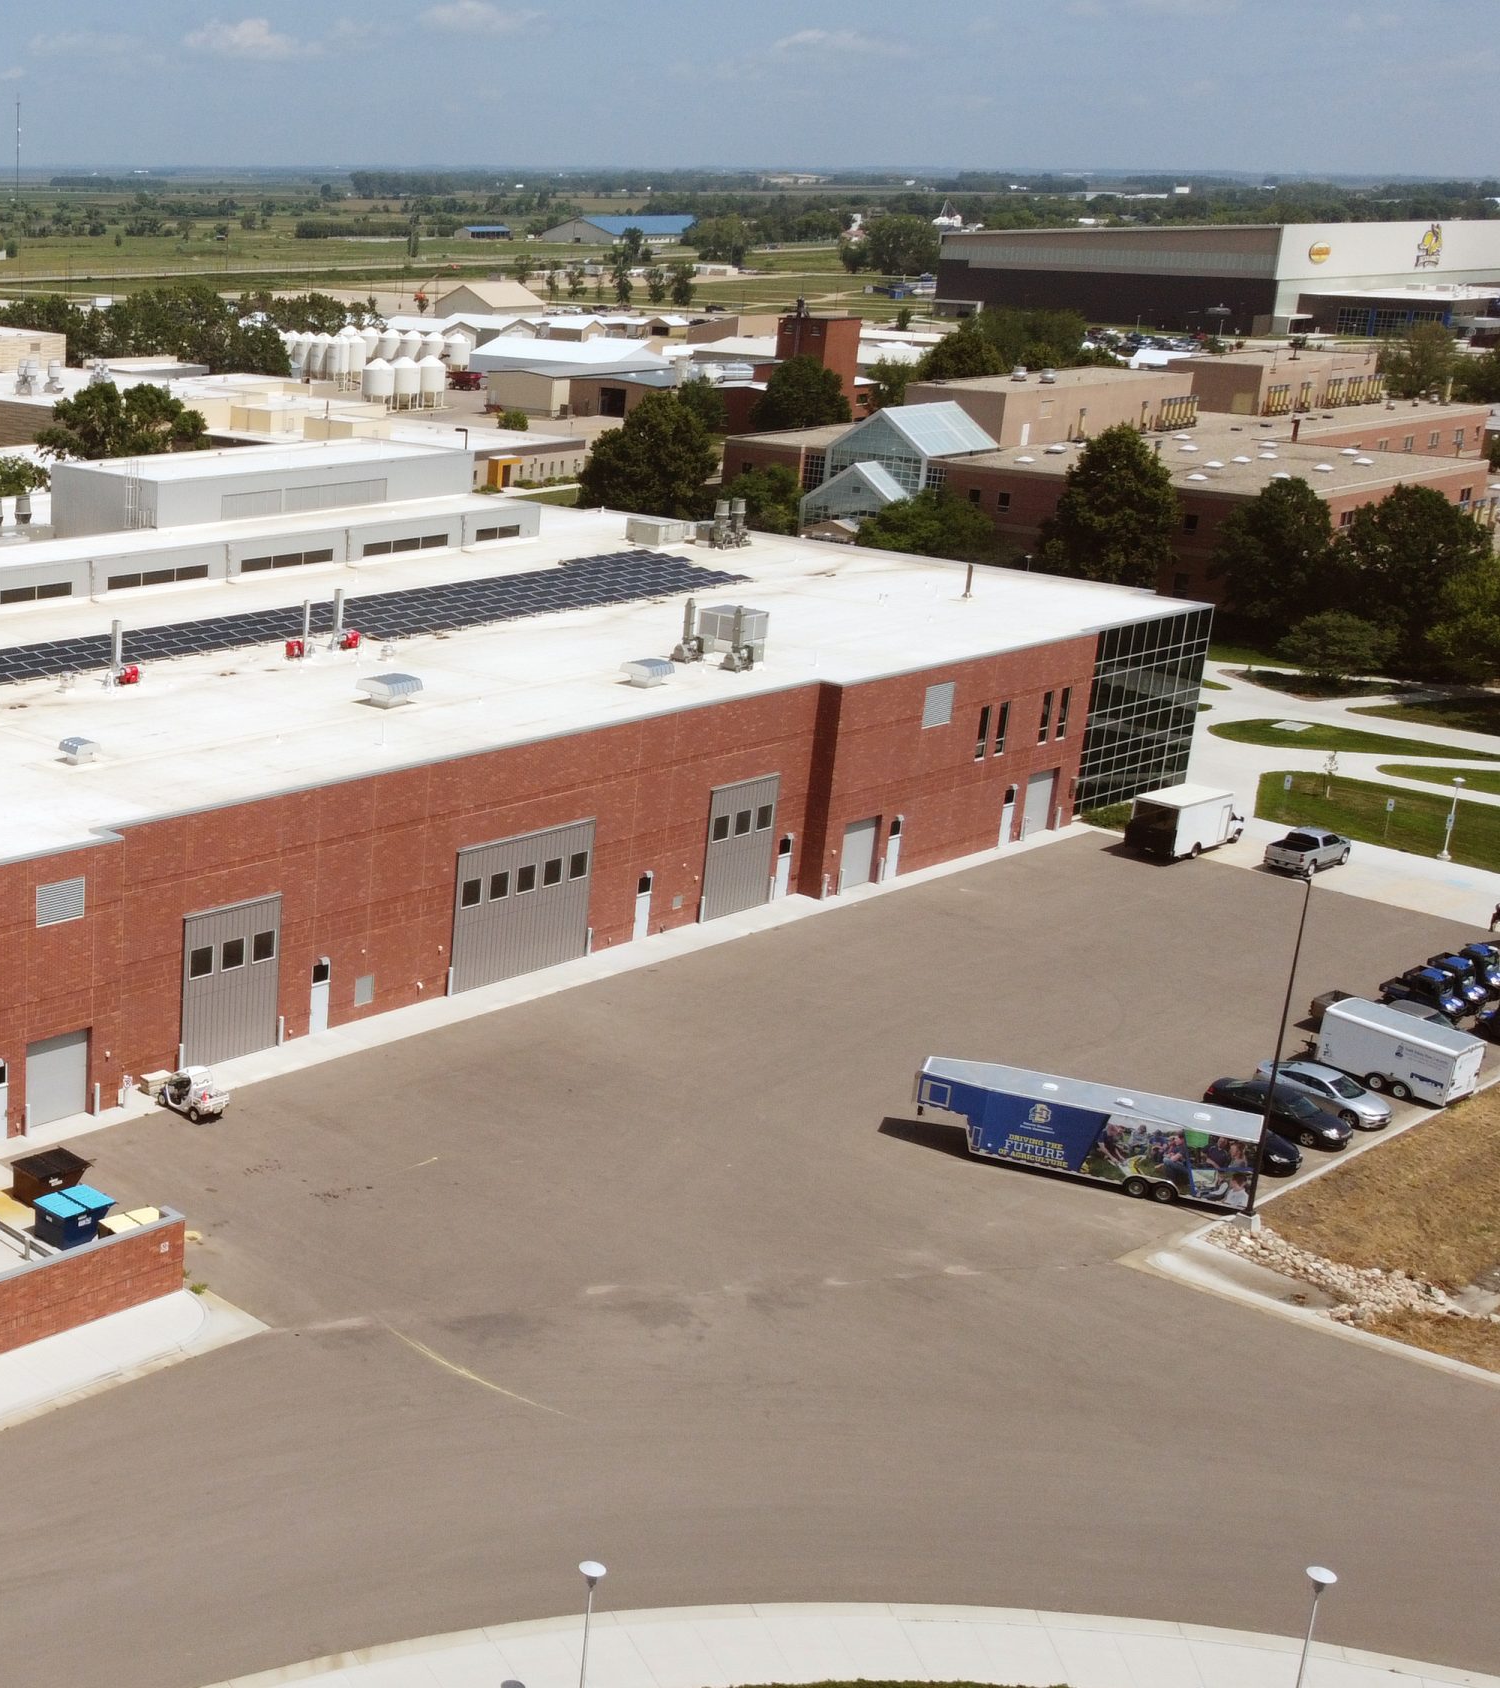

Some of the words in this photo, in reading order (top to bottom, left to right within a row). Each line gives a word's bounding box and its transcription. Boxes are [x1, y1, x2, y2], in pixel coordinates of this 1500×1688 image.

[1004, 1140, 1065, 1160] FUTURE
[1008, 1134, 1044, 1146] DRIVING
[1045, 1141, 1064, 1150] THE
[998, 1148, 1009, 1156] OF
[1011, 1151, 1068, 1168] AGRICULTURE
